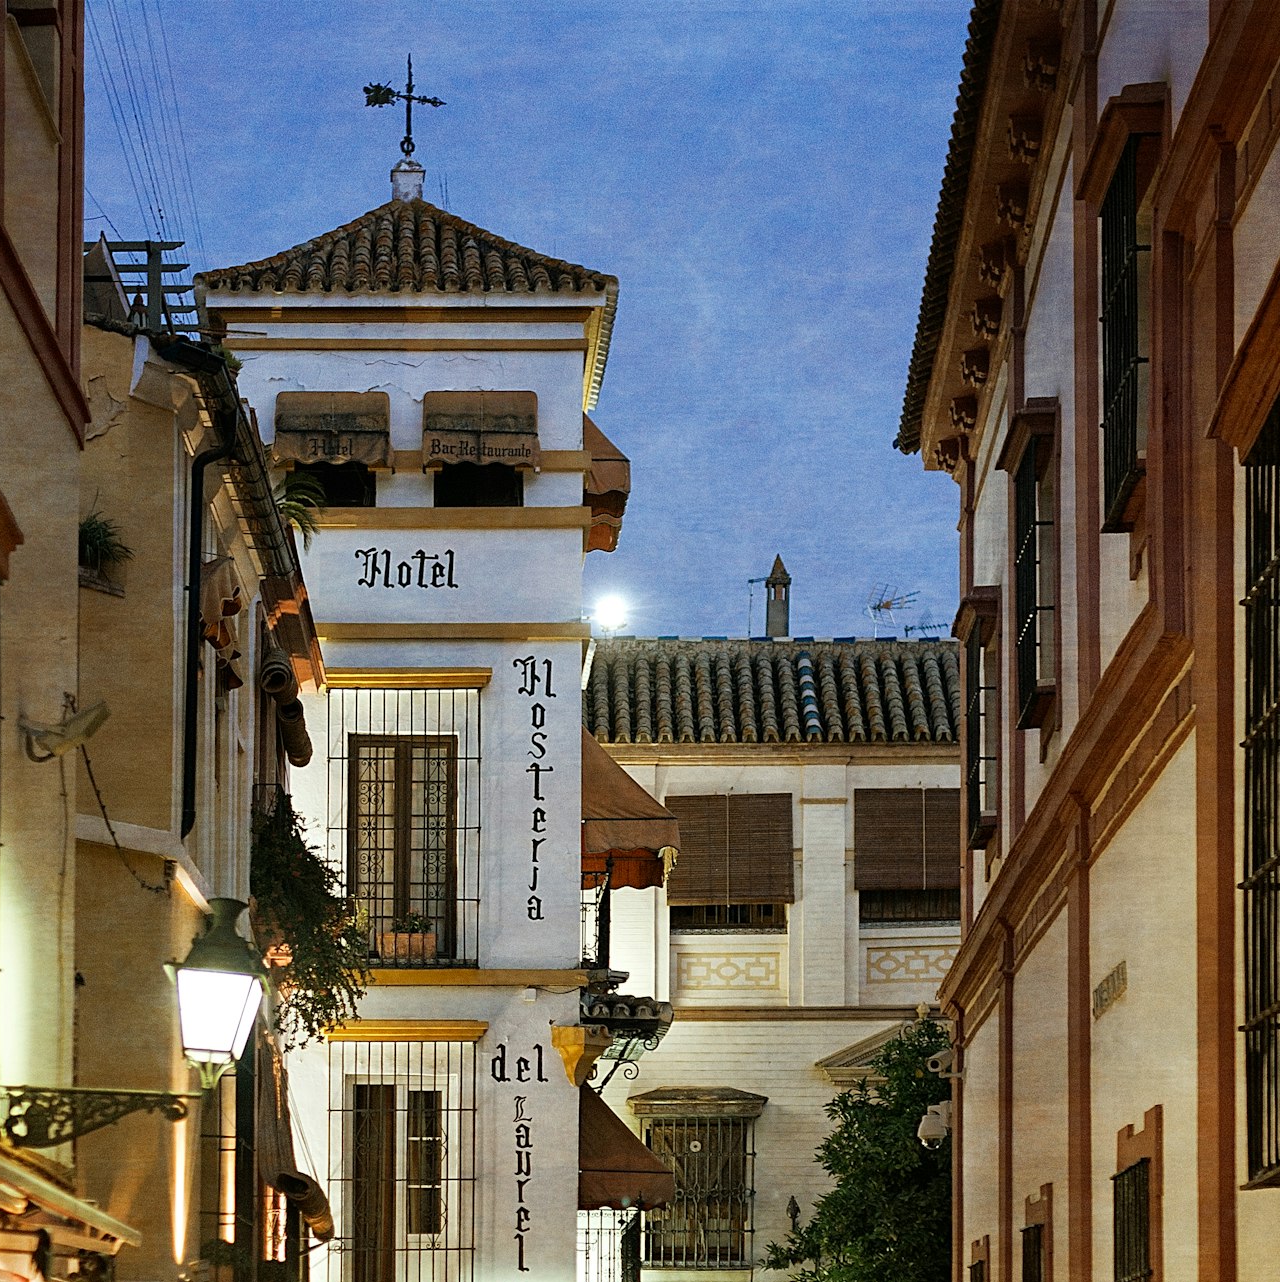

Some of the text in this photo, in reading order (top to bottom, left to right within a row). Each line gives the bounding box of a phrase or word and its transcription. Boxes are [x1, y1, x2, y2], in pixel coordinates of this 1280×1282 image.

[355, 547, 458, 589] Hotel
[491, 1043, 548, 1084] del
[513, 1095, 534, 1273] Laurel
